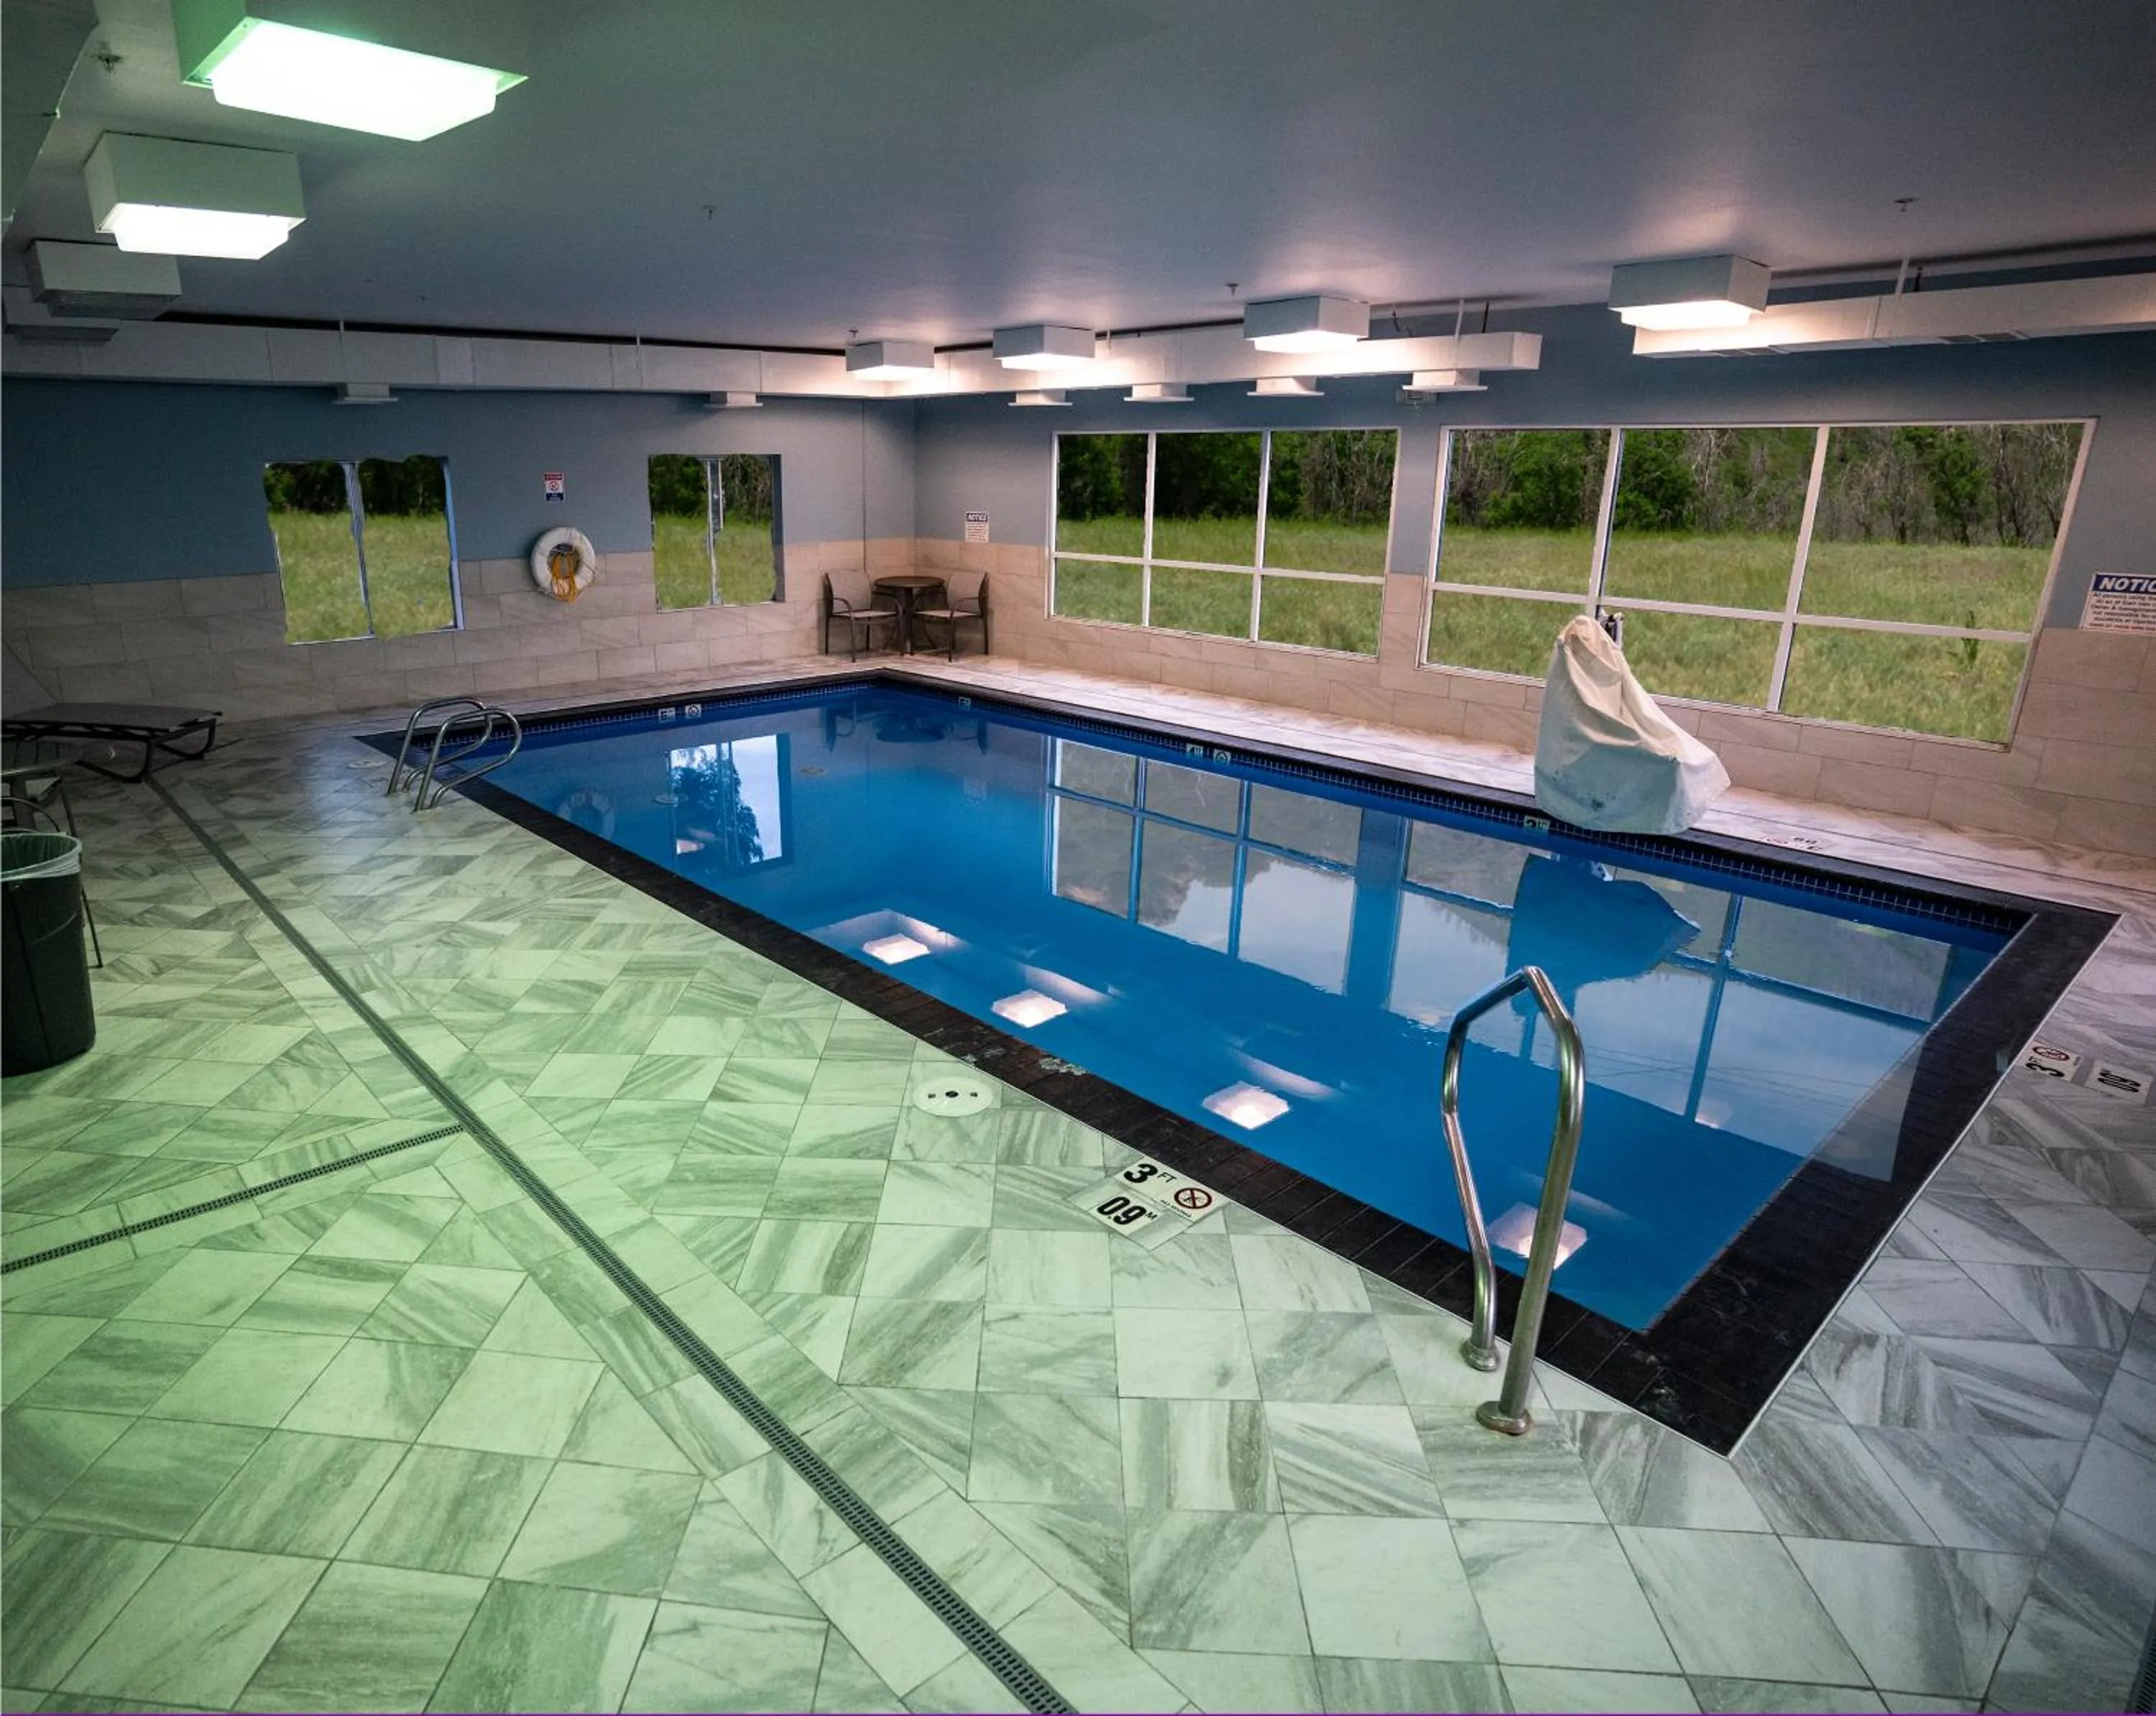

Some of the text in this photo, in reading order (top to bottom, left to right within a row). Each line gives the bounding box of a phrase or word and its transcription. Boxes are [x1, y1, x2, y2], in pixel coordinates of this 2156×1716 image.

[2024, 1062, 2065, 1077] 3
[1123, 1163, 1178, 1184] 3 FT
[1096, 1196, 1148, 1225] 0.9
